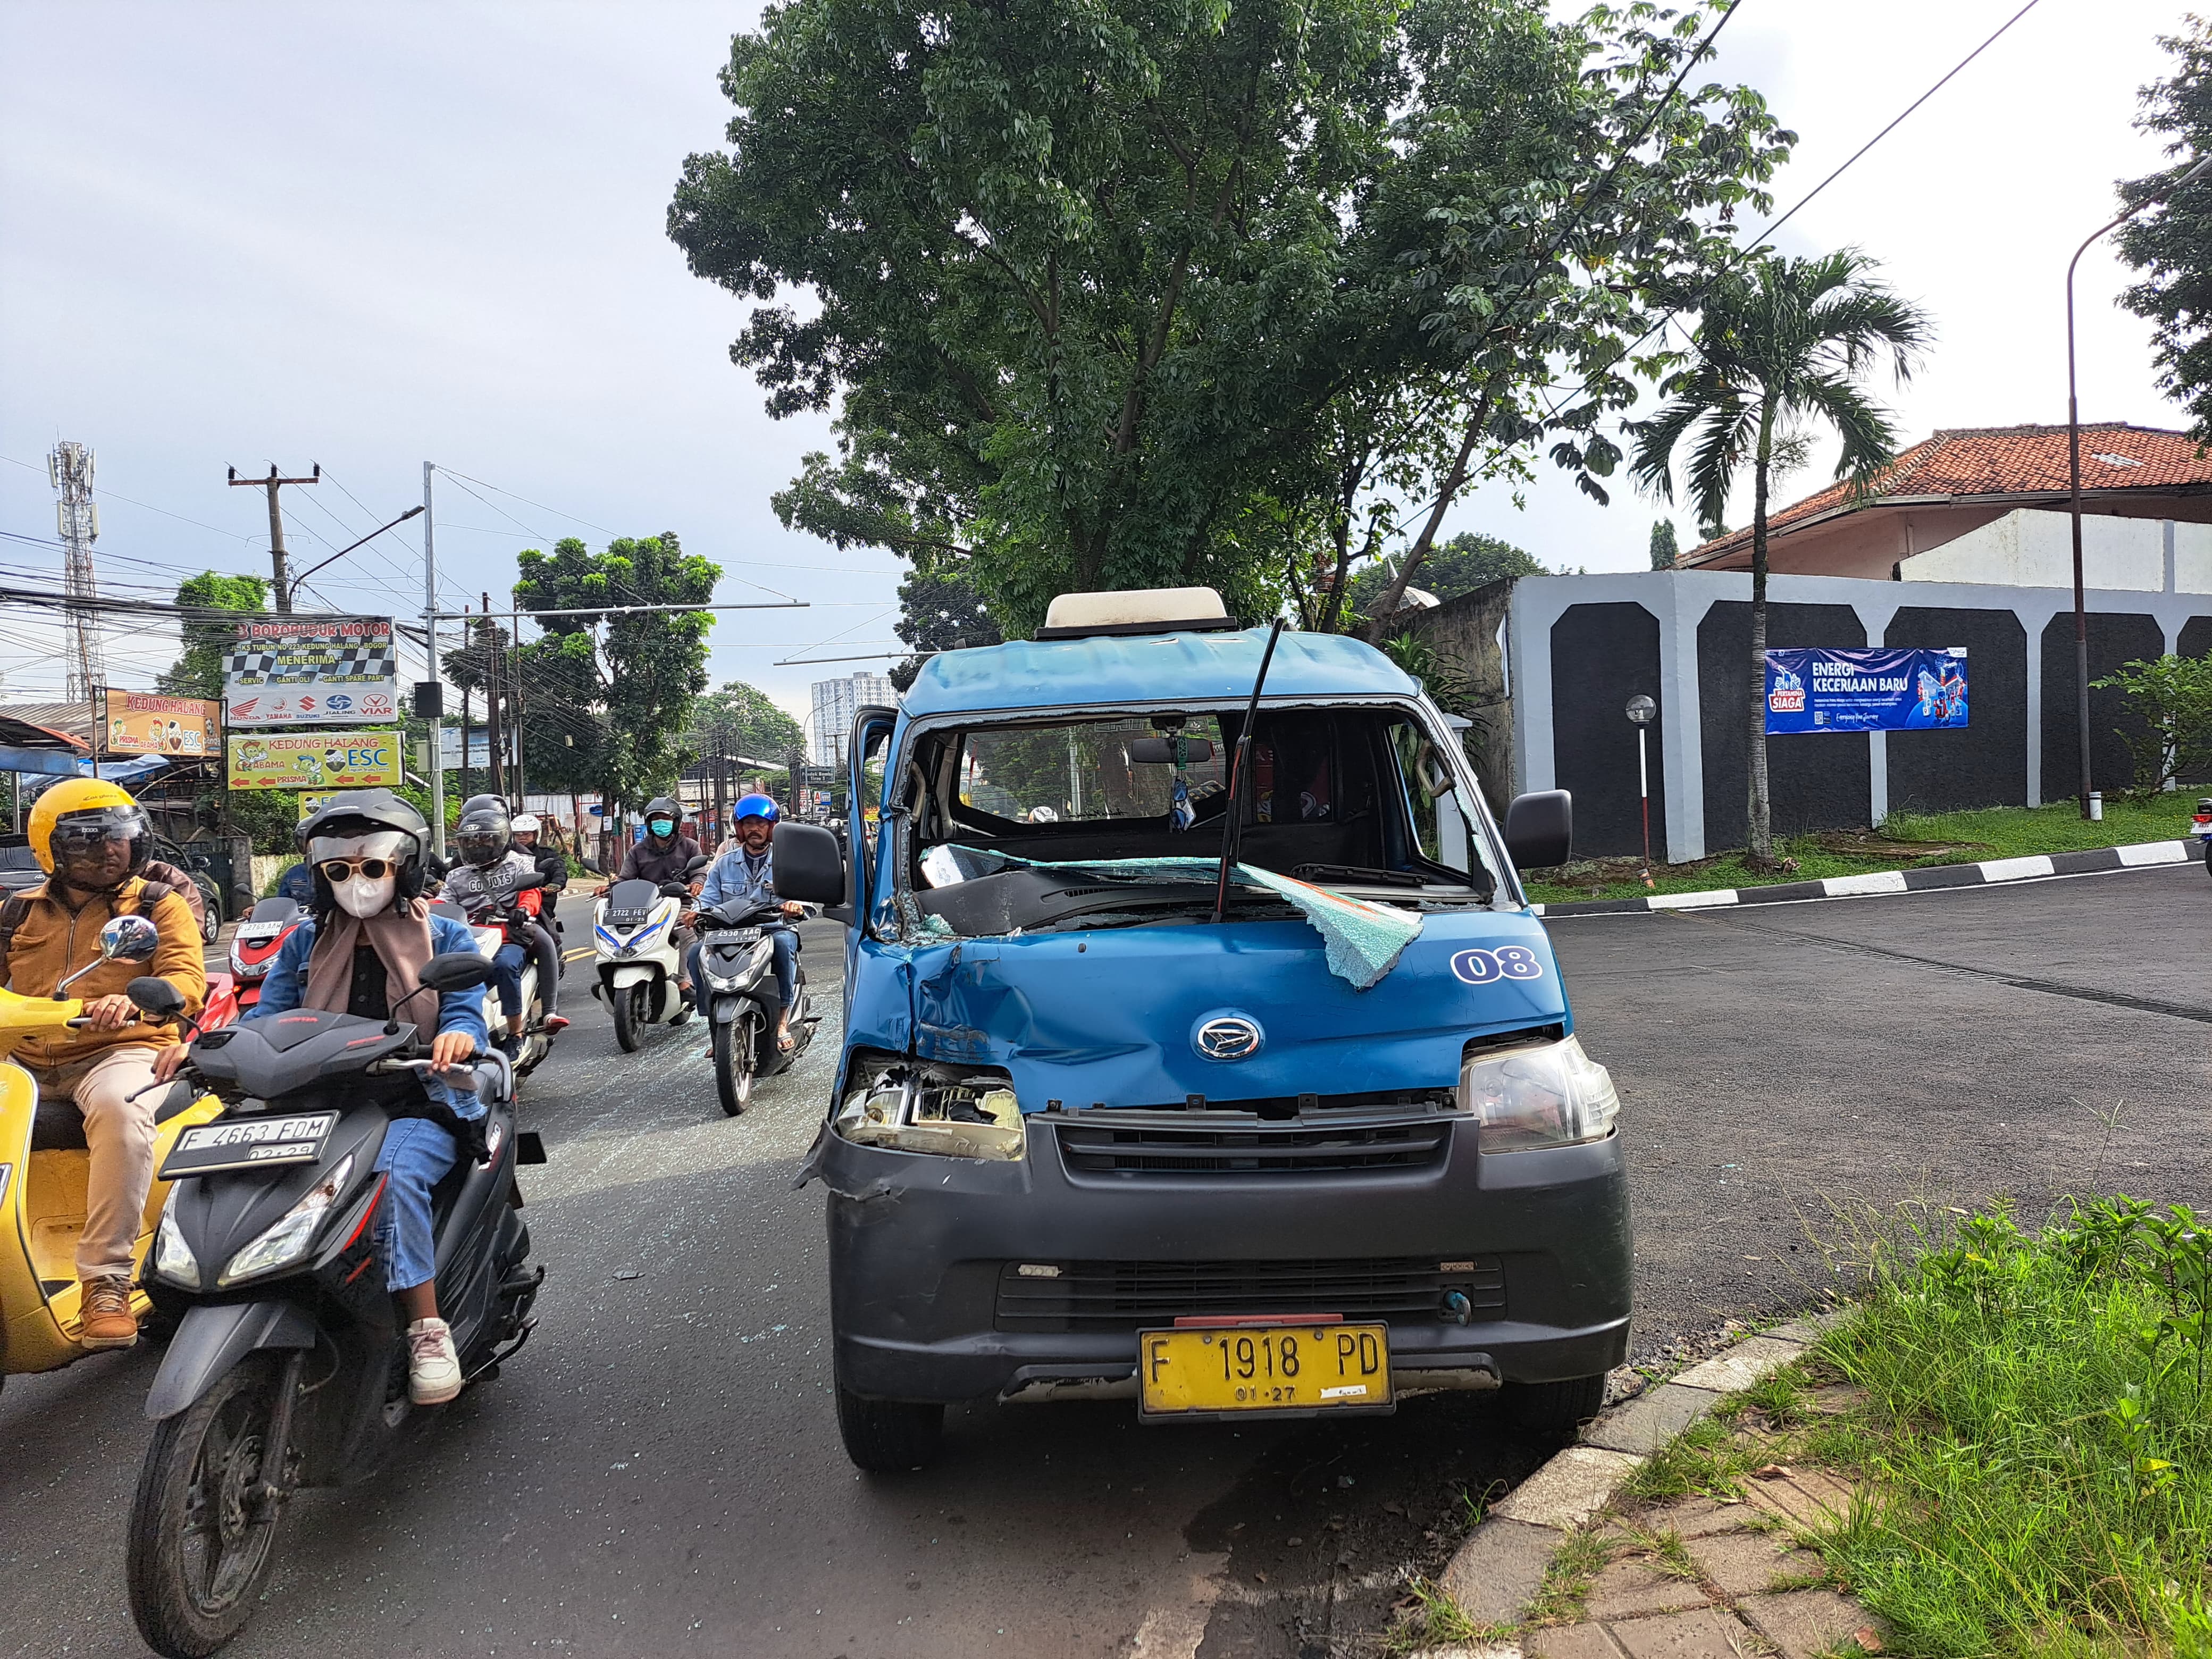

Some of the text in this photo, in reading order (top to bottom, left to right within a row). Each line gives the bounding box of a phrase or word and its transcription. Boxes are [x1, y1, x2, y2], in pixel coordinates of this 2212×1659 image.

[341, 622, 391, 637] MOTOR
[277, 655, 336, 666] MENERIMA
[1812, 662, 1854, 677] ENERGI
[1813, 677, 1908, 692] KECERIAAN BARU
[126, 694, 206, 716] KEDUNG HALANG
[1772, 697, 1802, 709] SIAGA
[119, 735, 139, 744] PRISMA
[183, 731, 201, 747] ESC
[269, 738, 378, 750] KEDUNG HALANG
[253, 760, 285, 769] ABAMA
[348, 748, 389, 767] ESC
[1450, 945, 1543, 985] 08
[183, 1131, 201, 1150] F
[212, 1124, 269, 1146] 4663
[1150, 1332, 1379, 1382] F 1918 PD
